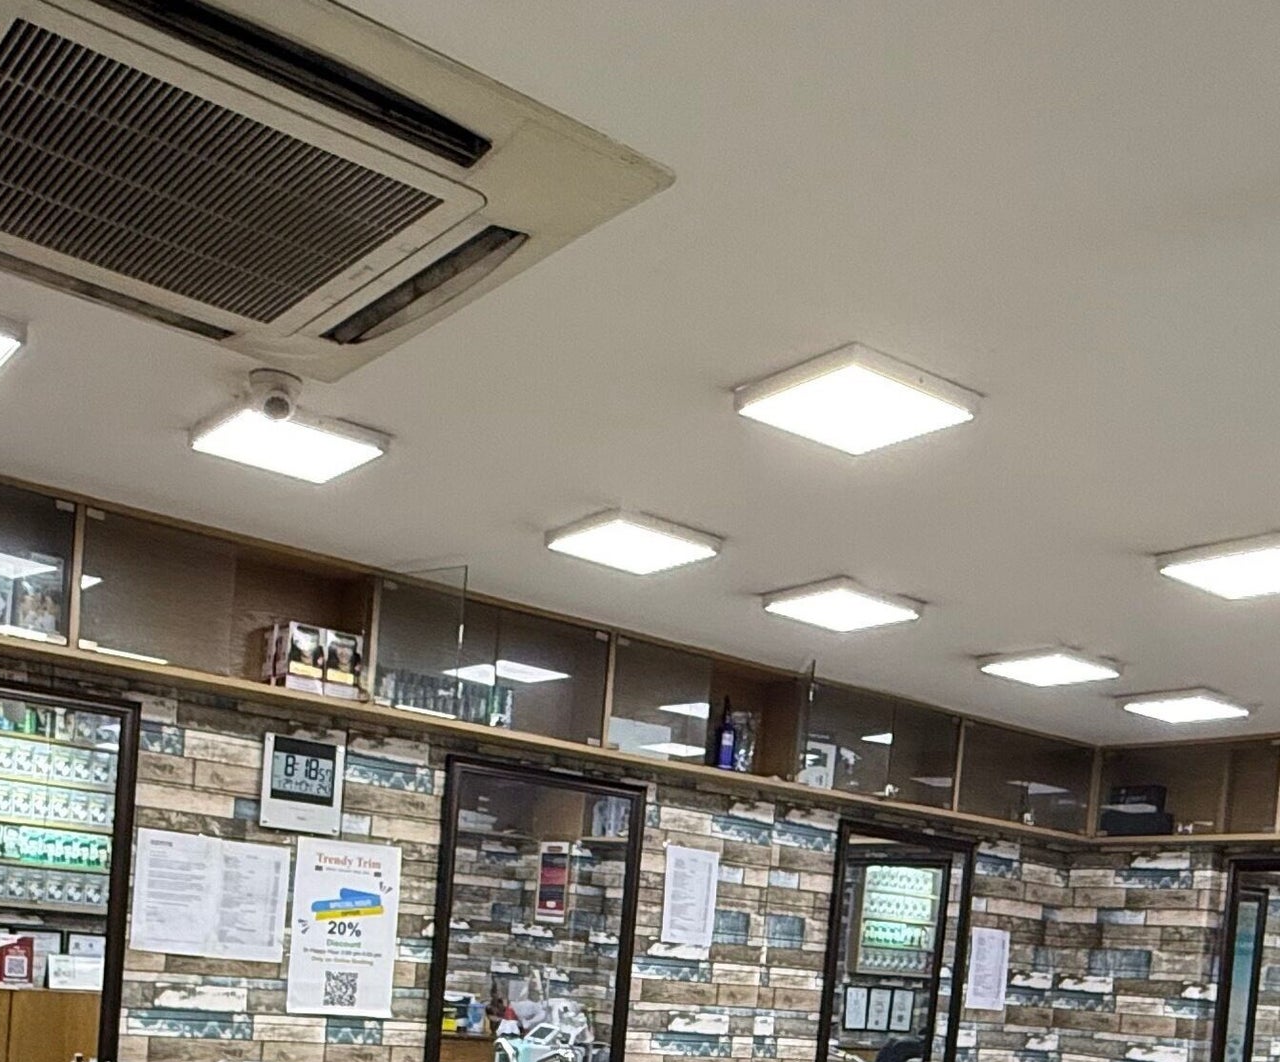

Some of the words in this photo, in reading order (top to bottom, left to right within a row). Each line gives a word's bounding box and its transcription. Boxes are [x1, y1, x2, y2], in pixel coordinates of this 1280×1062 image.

[317, 852, 353, 868] Trendy
[357, 857, 381, 869] Trim
[327, 921, 361, 937] 20%
[326, 939, 361, 948] Discount
